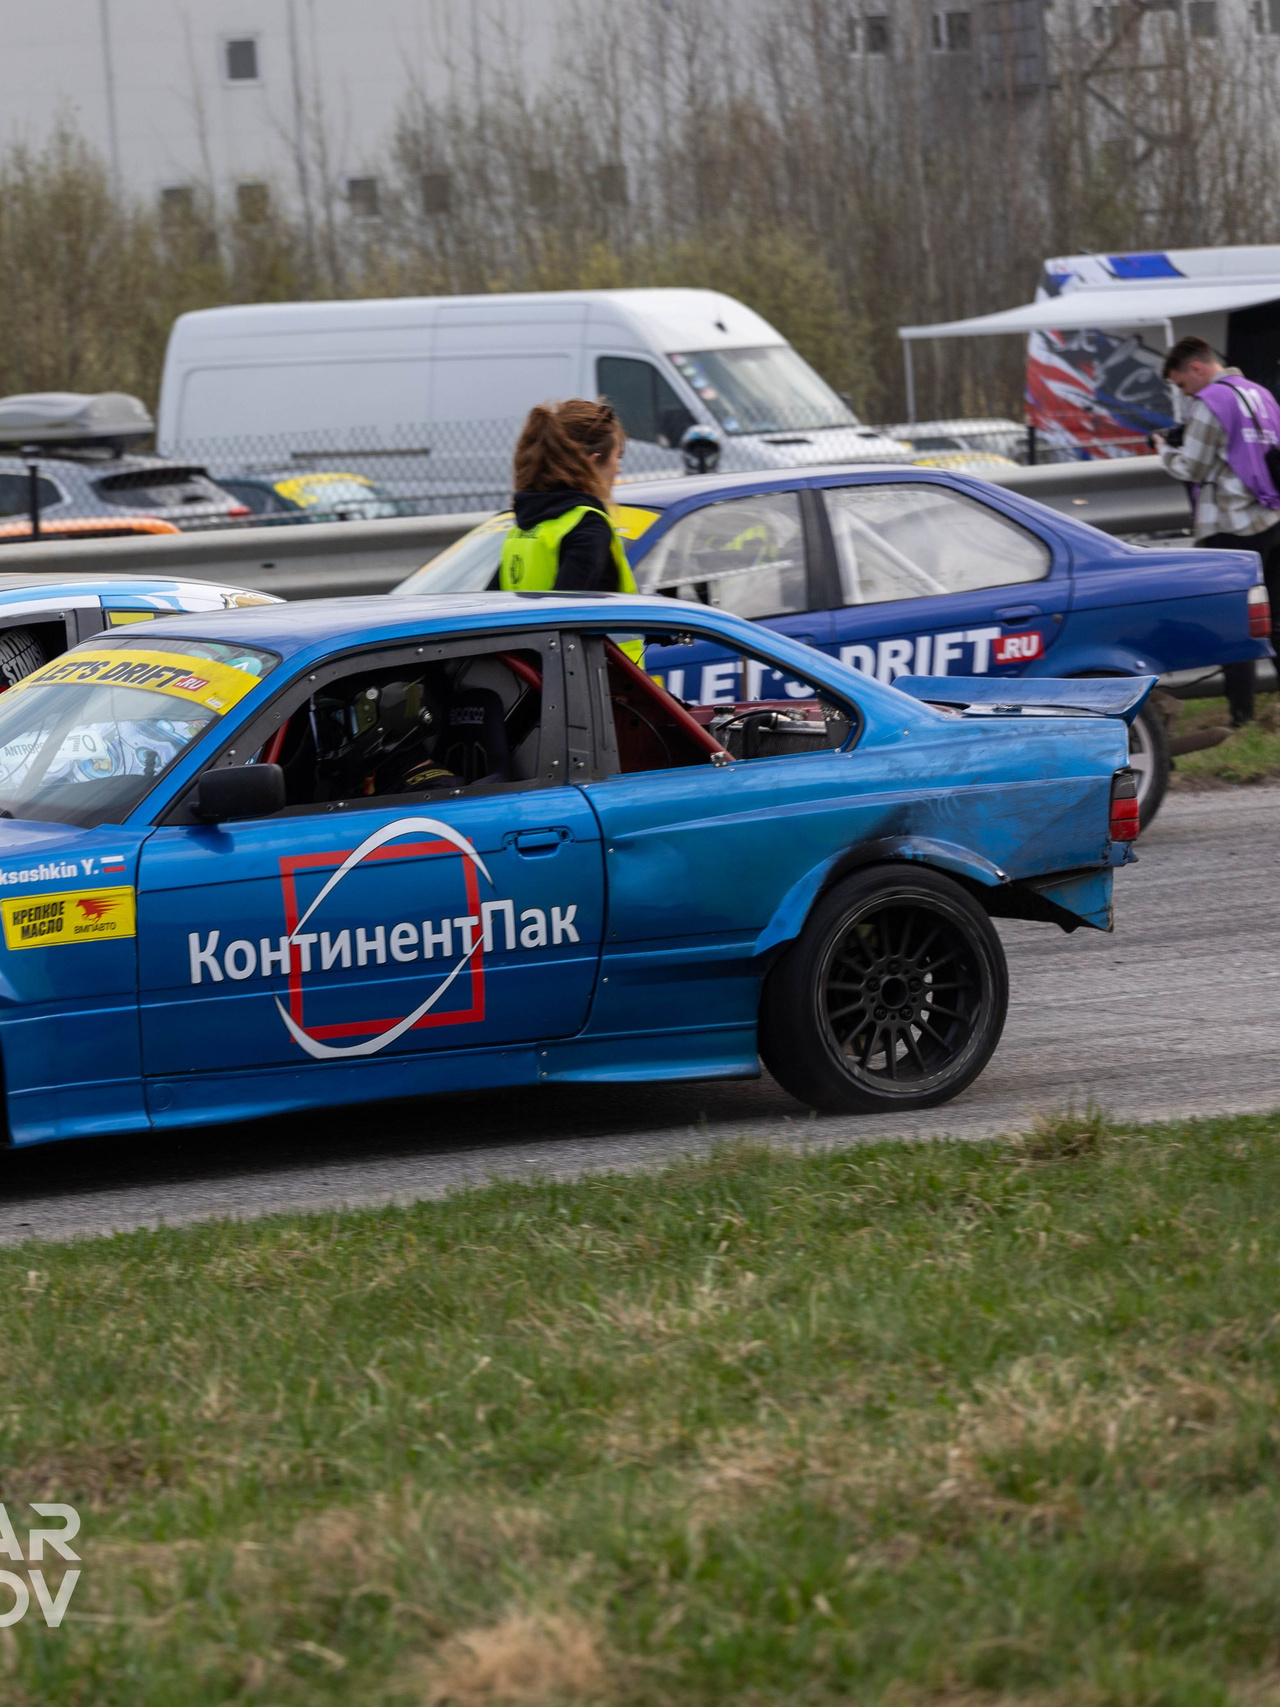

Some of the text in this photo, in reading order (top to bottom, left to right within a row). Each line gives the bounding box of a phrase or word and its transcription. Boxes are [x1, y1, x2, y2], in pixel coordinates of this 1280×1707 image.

[30, 661, 106, 684] LET'S
[80, 858, 100, 875] Y.
[12, 901, 66, 925] КРЕПКОЕ
[21, 917, 64, 940] МАСЛО
[74, 922, 116, 934] ВМПАВТО
[187, 899, 581, 984] КонтинентПак
